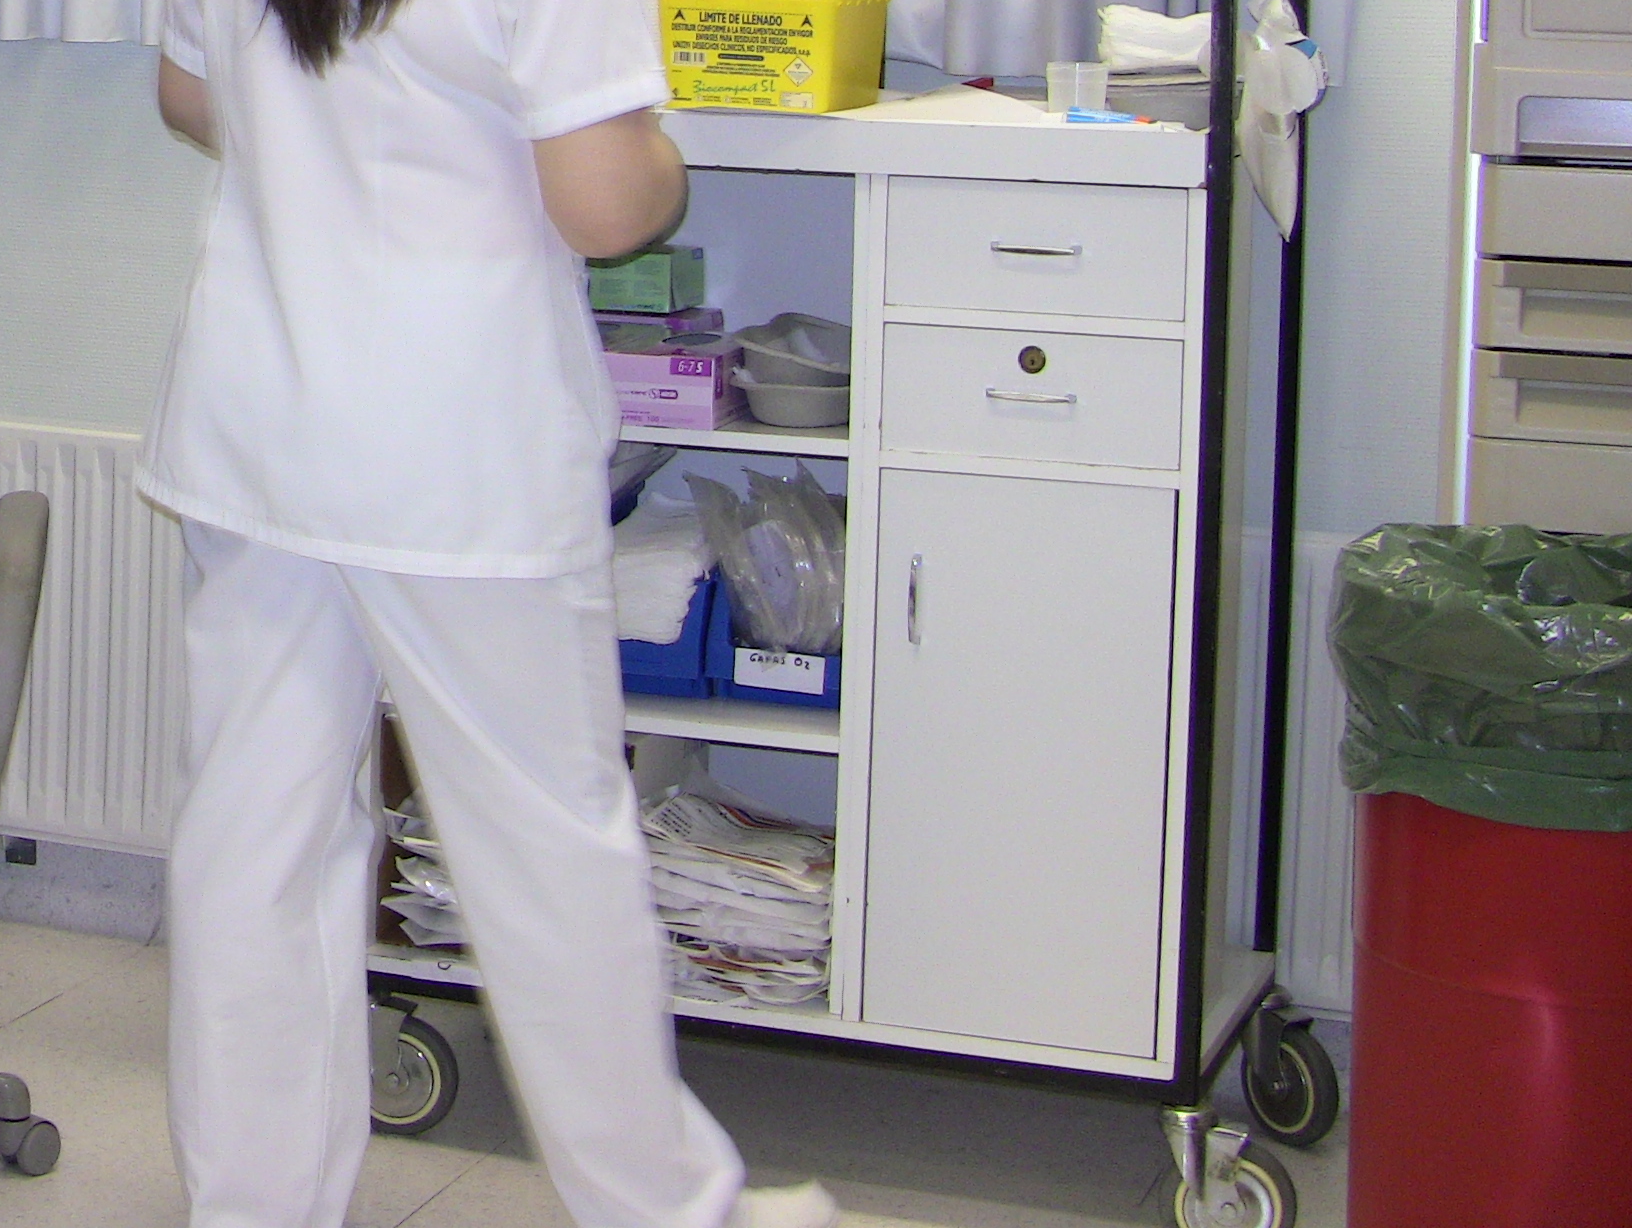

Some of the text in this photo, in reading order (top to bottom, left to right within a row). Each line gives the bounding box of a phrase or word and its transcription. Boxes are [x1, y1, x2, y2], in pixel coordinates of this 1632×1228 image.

[699, 11, 783, 27] LIMITE DE LLENADO
[696, 24, 726, 33] CONFORME
[731, 25, 739, 34] LA
[760, 36, 767, 44] DE
[768, 37, 788, 46] RIESGO
[678, 360, 704, 373] 6-7 S
